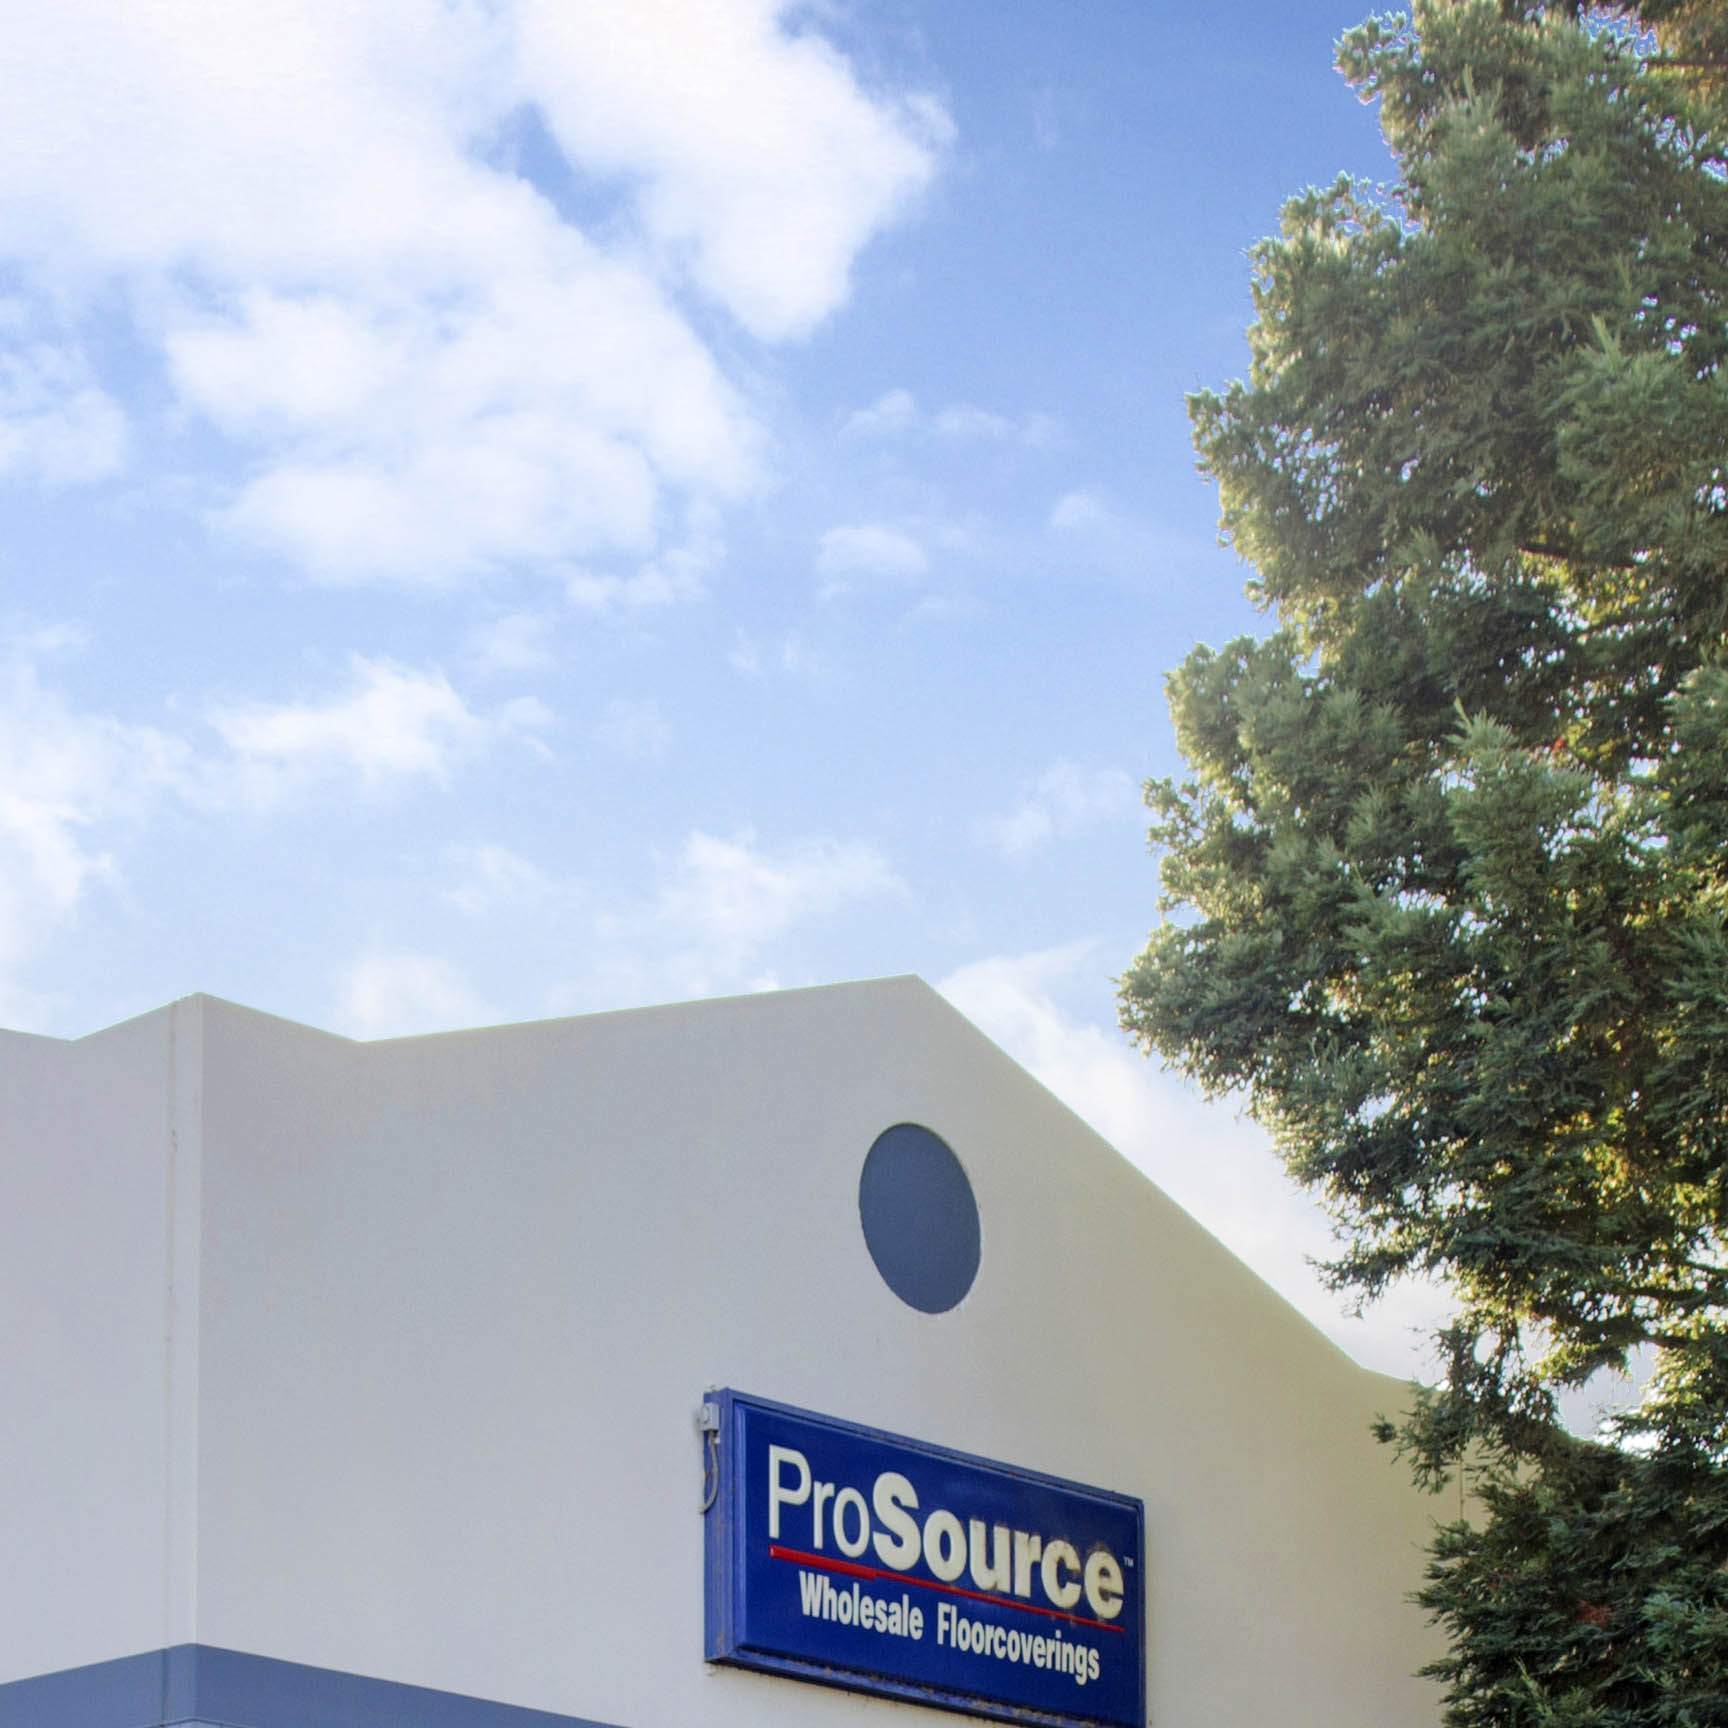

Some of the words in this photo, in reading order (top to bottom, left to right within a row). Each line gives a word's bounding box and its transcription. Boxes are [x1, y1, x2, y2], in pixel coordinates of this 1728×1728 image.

[769, 1443, 1124, 1619] ProSource
[799, 1570, 923, 1640] Wholesale
[937, 1602, 1101, 1686] Floorcoverings
